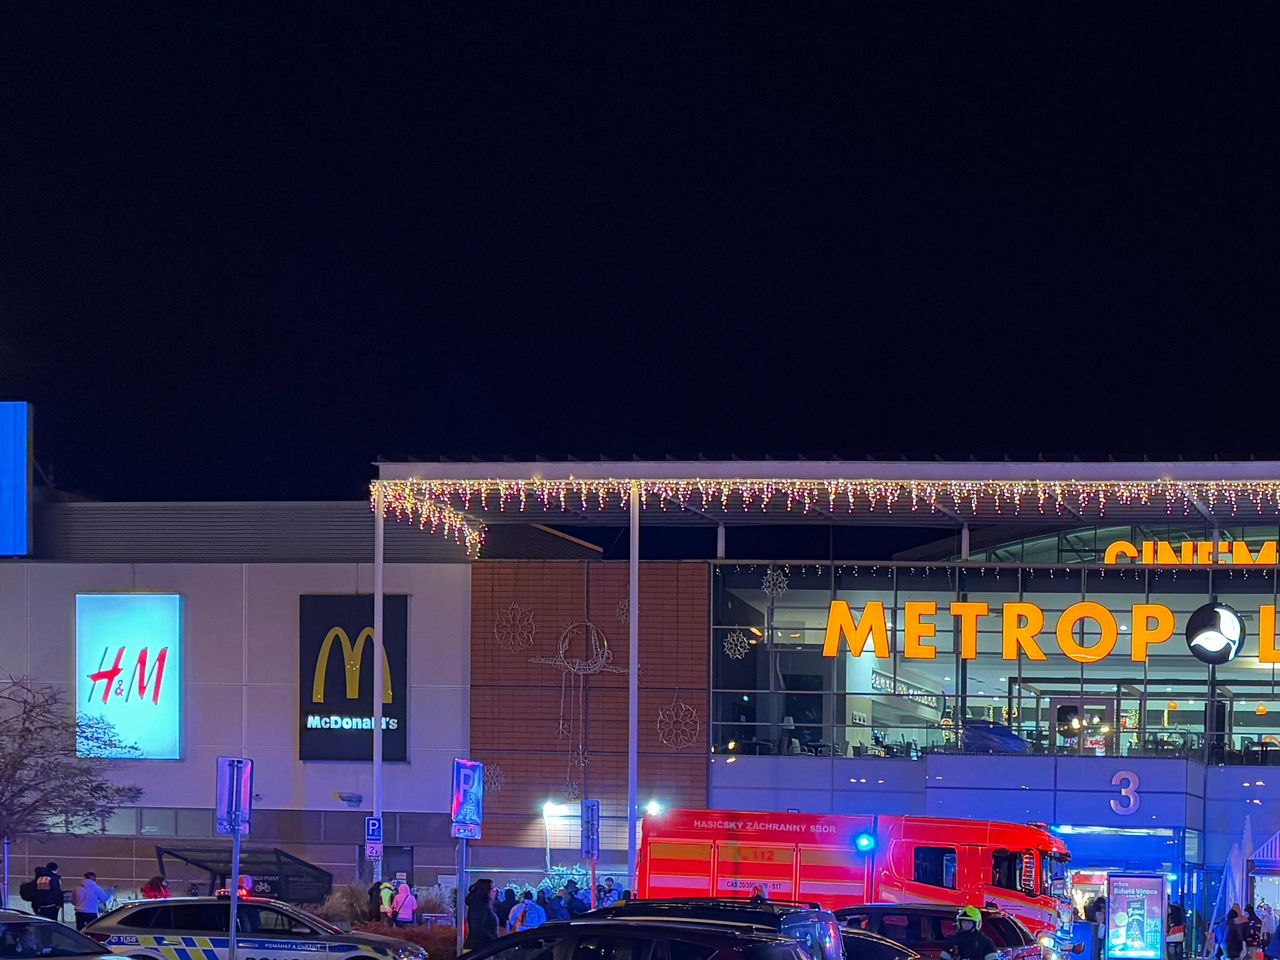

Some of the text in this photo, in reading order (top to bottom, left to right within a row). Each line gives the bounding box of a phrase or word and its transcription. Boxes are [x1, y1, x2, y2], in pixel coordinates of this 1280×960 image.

[87, 646, 169, 705] H&M
[1110, 770, 1141, 816] 3
[369, 820, 379, 835] P
[810, 825, 837, 833] SBOR
[753, 850, 775, 861] 112
[1047, 913, 1053, 922] 7
